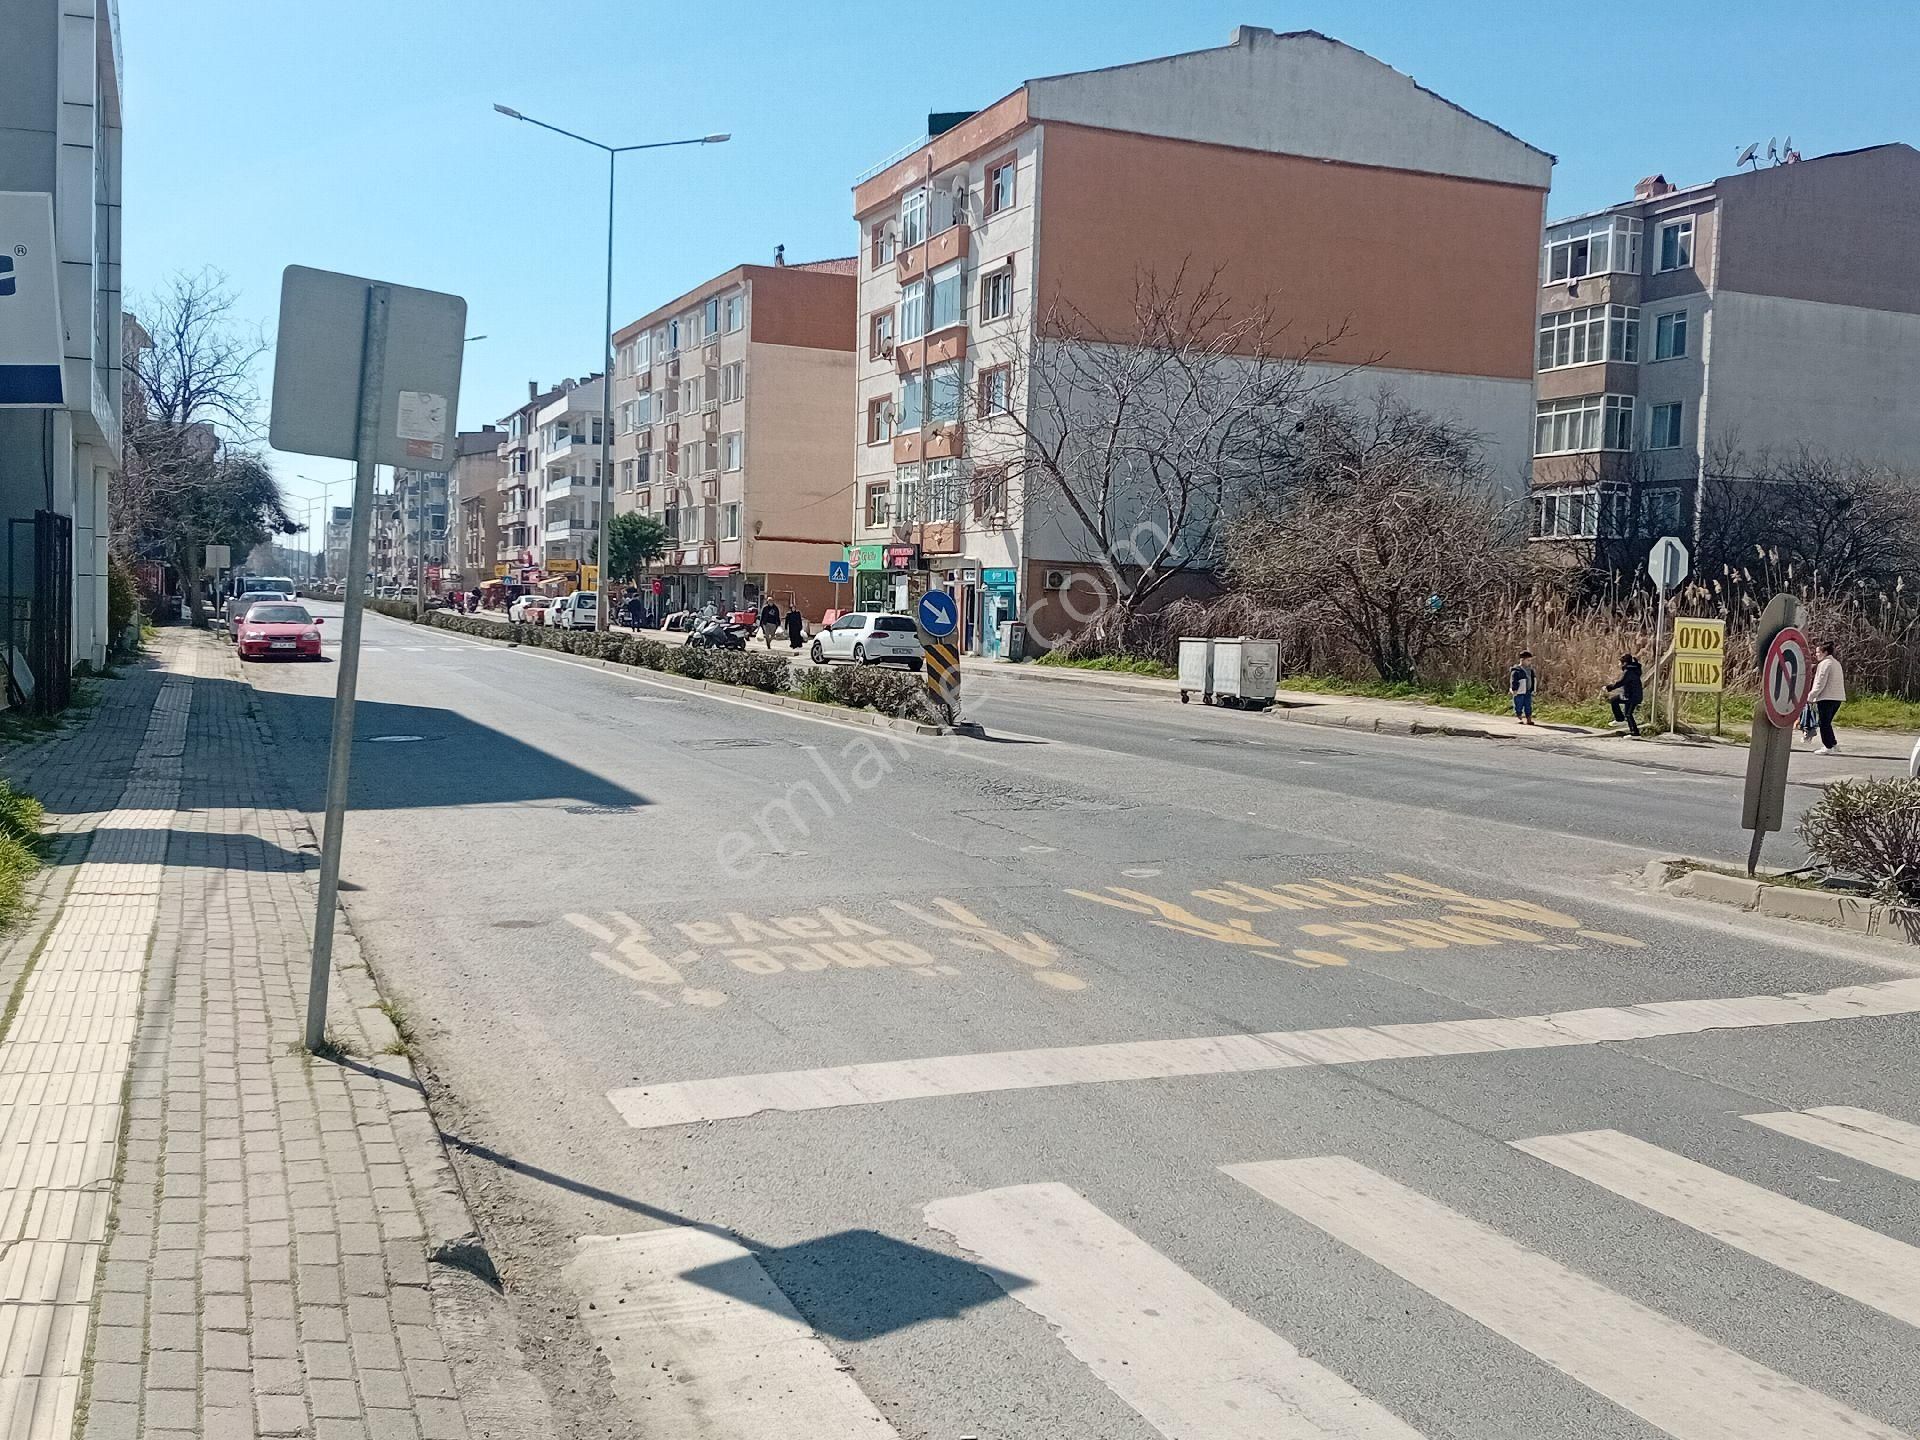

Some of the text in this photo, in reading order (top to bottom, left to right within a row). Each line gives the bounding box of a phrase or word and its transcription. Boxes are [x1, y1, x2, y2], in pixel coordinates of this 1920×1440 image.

[1680, 627, 1712, 650] OTO
[1679, 662, 1711, 685] YIKAMA
[718, 938, 961, 977] önce
